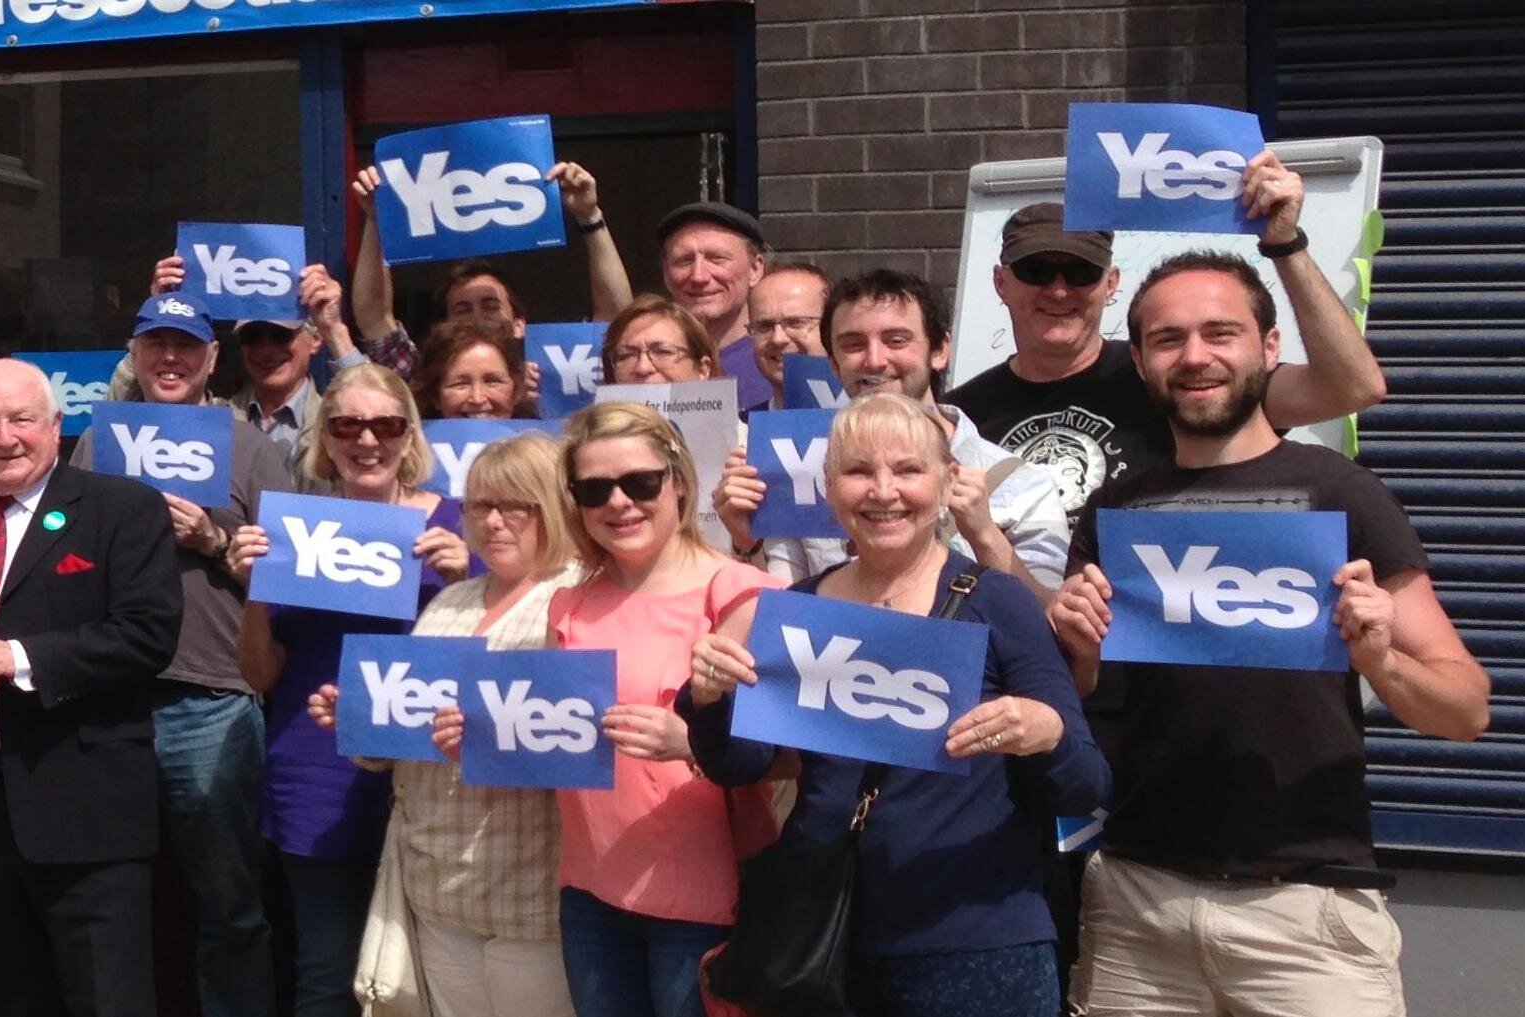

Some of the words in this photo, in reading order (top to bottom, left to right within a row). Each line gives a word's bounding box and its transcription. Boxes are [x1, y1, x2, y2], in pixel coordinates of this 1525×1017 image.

[381, 151, 546, 236] Yes
[1096, 132, 1247, 200] Yes
[193, 244, 292, 296] Yes
[157, 298, 195, 317] Yes
[543, 344, 604, 395] Ye
[663, 397, 723, 414] Independence
[111, 423, 215, 481] Yes
[281, 515, 403, 588] Yes
[1132, 544, 1319, 629] Yes
[360, 661, 459, 728] Yes
[781, 625, 950, 730] Yes
[478, 680, 598, 754] Yes
